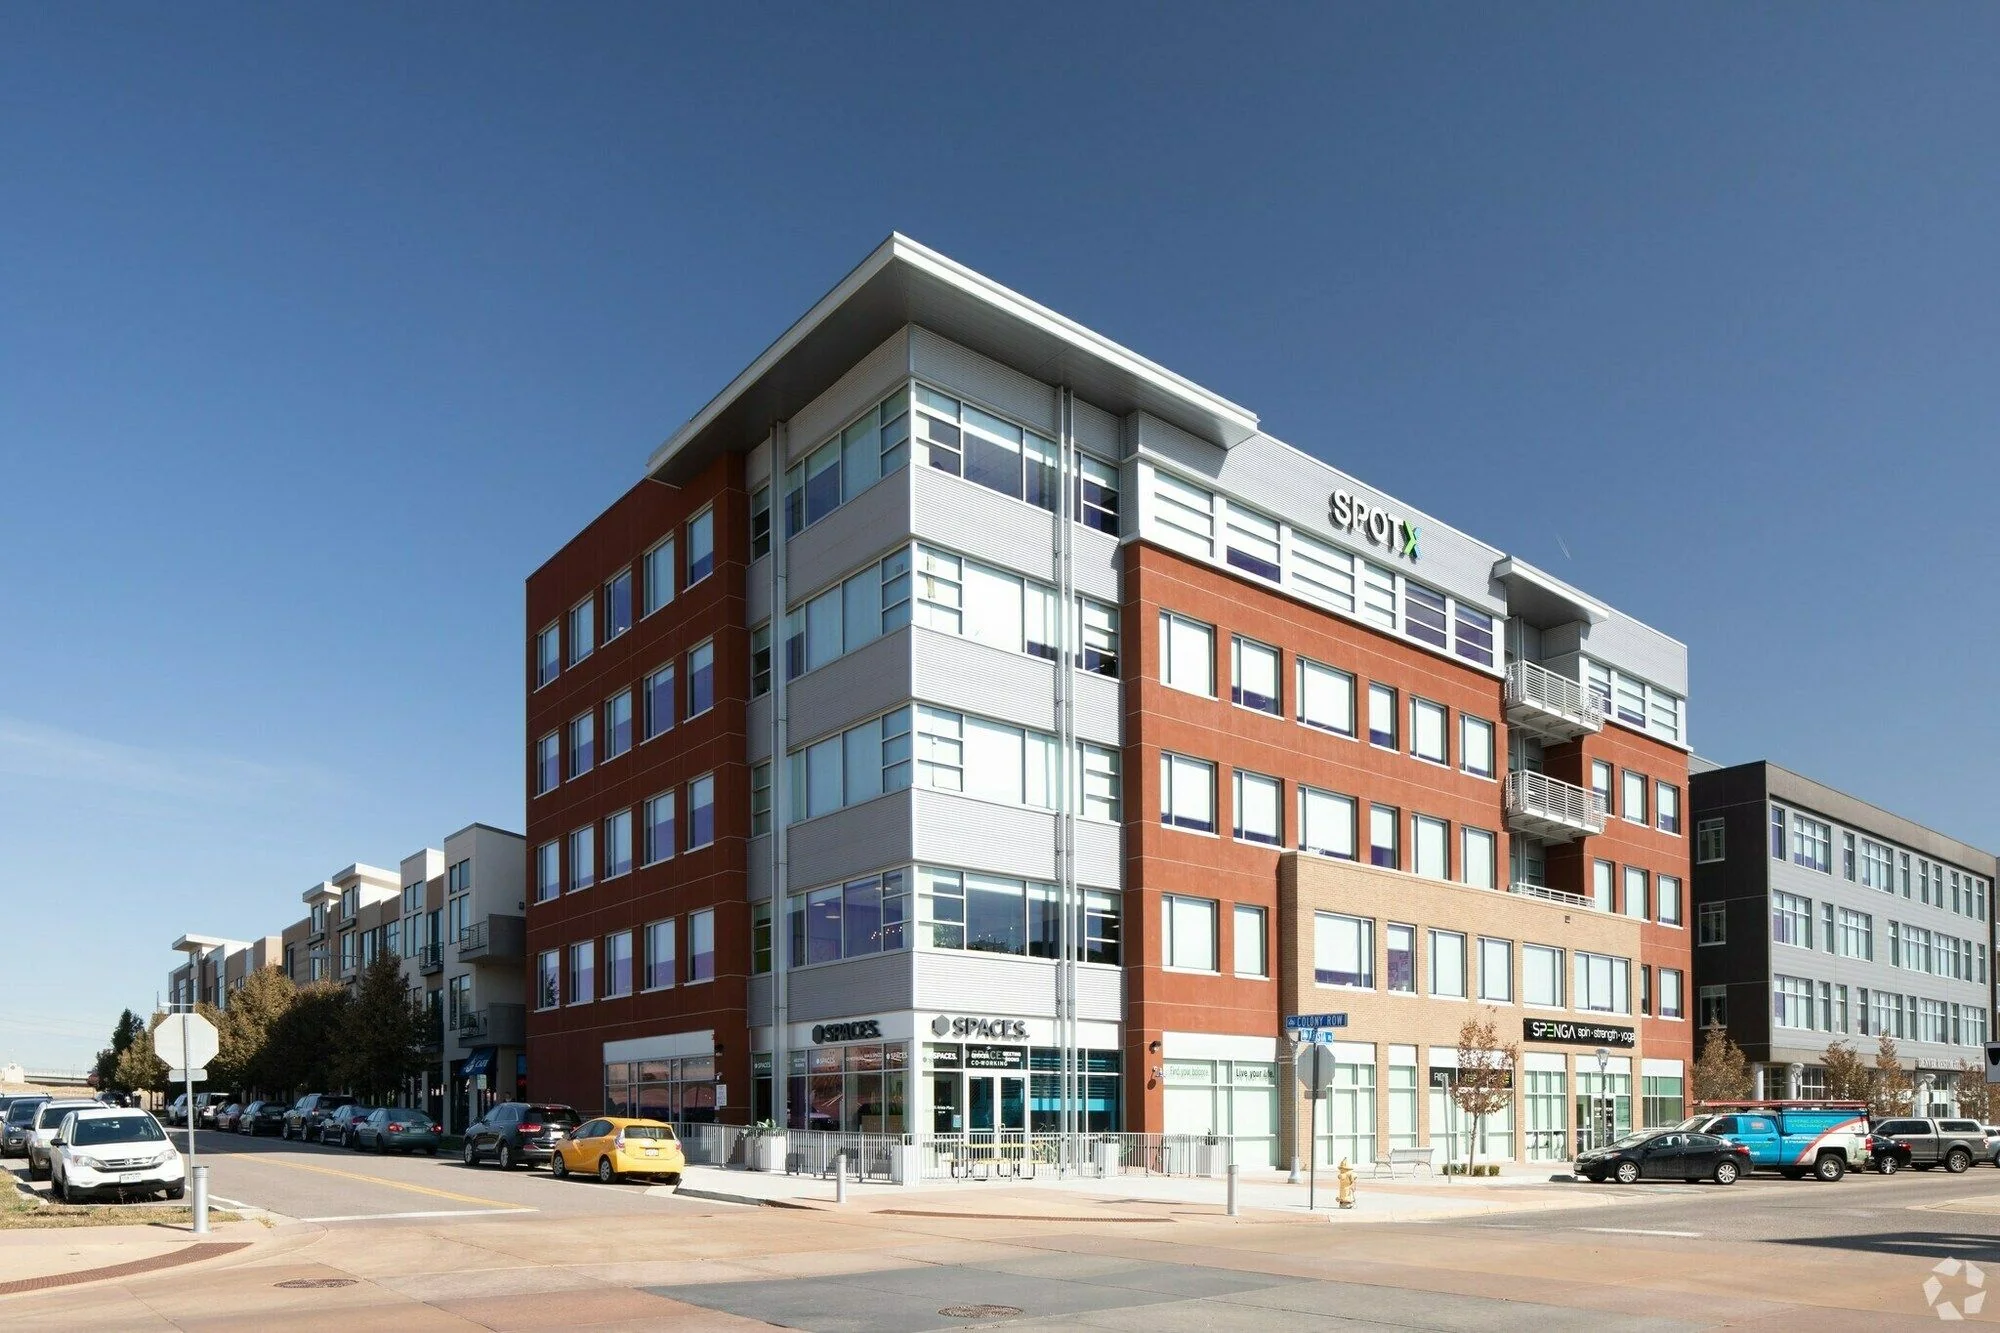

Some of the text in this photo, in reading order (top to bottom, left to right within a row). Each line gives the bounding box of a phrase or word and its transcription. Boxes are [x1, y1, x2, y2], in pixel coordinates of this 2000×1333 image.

[1328, 488, 1423, 562] SPOTX
[1297, 1015, 1343, 1027] COLONY ROW
[1532, 1021, 1636, 1043] SPENGA spin strength yoga
[1235, 1068, 1248, 1078] Live
[1249, 1069, 1262, 1079] your
